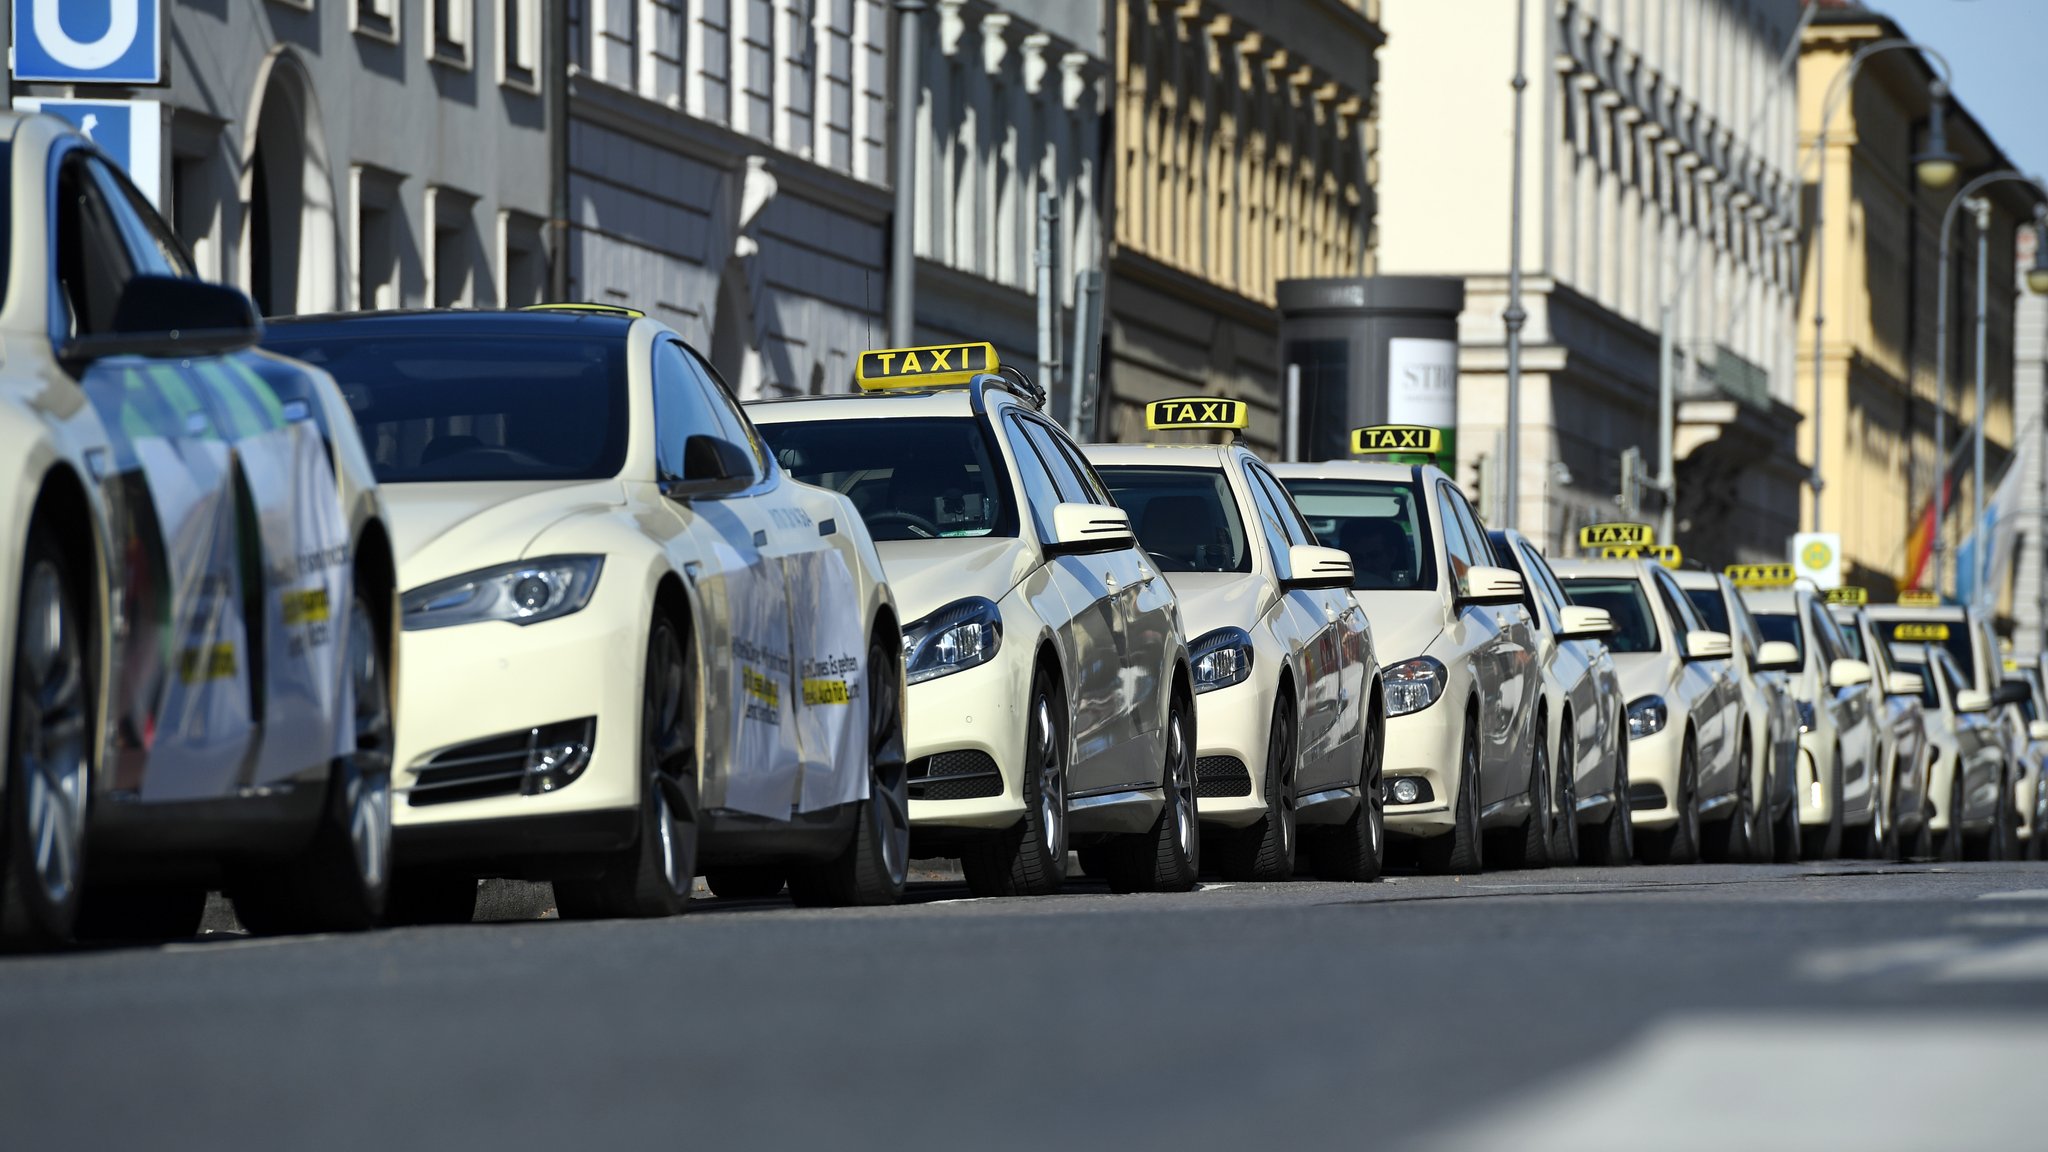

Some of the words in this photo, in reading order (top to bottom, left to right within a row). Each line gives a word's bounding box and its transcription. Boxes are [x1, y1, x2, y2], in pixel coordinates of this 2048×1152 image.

[877, 347, 969, 375] TAXI
[1162, 403, 1228, 422] TAXI
[1366, 430, 1424, 447] TAXI
[1592, 527, 1639, 541] TAXI
[1612, 547, 1666, 563] TAI
[1734, 566, 1784, 580] TAXI
